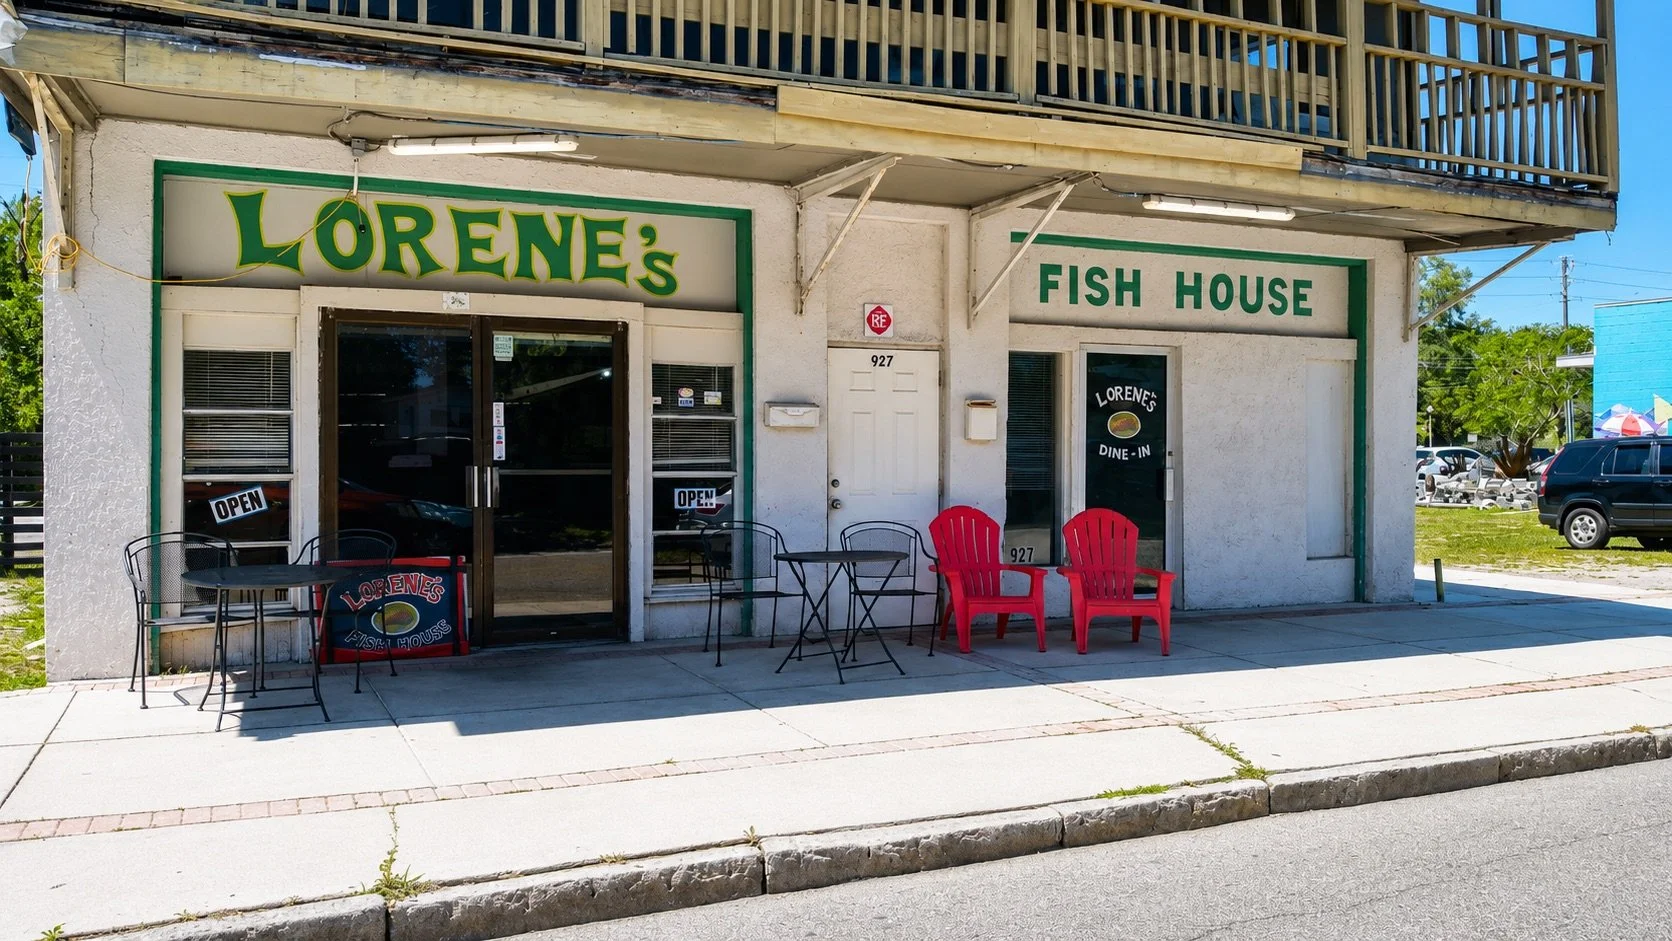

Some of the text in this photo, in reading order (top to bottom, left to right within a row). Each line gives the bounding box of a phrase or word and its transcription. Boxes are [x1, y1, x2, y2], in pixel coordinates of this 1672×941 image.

[1039, 263, 1313, 317] FISH HOUSE
[871, 354, 894, 367] 927
[214, 489, 263, 520] OPEN
[677, 490, 714, 507] OPEN
[1010, 547, 1034, 563] 927
[397, 619, 453, 651] HOUSE
